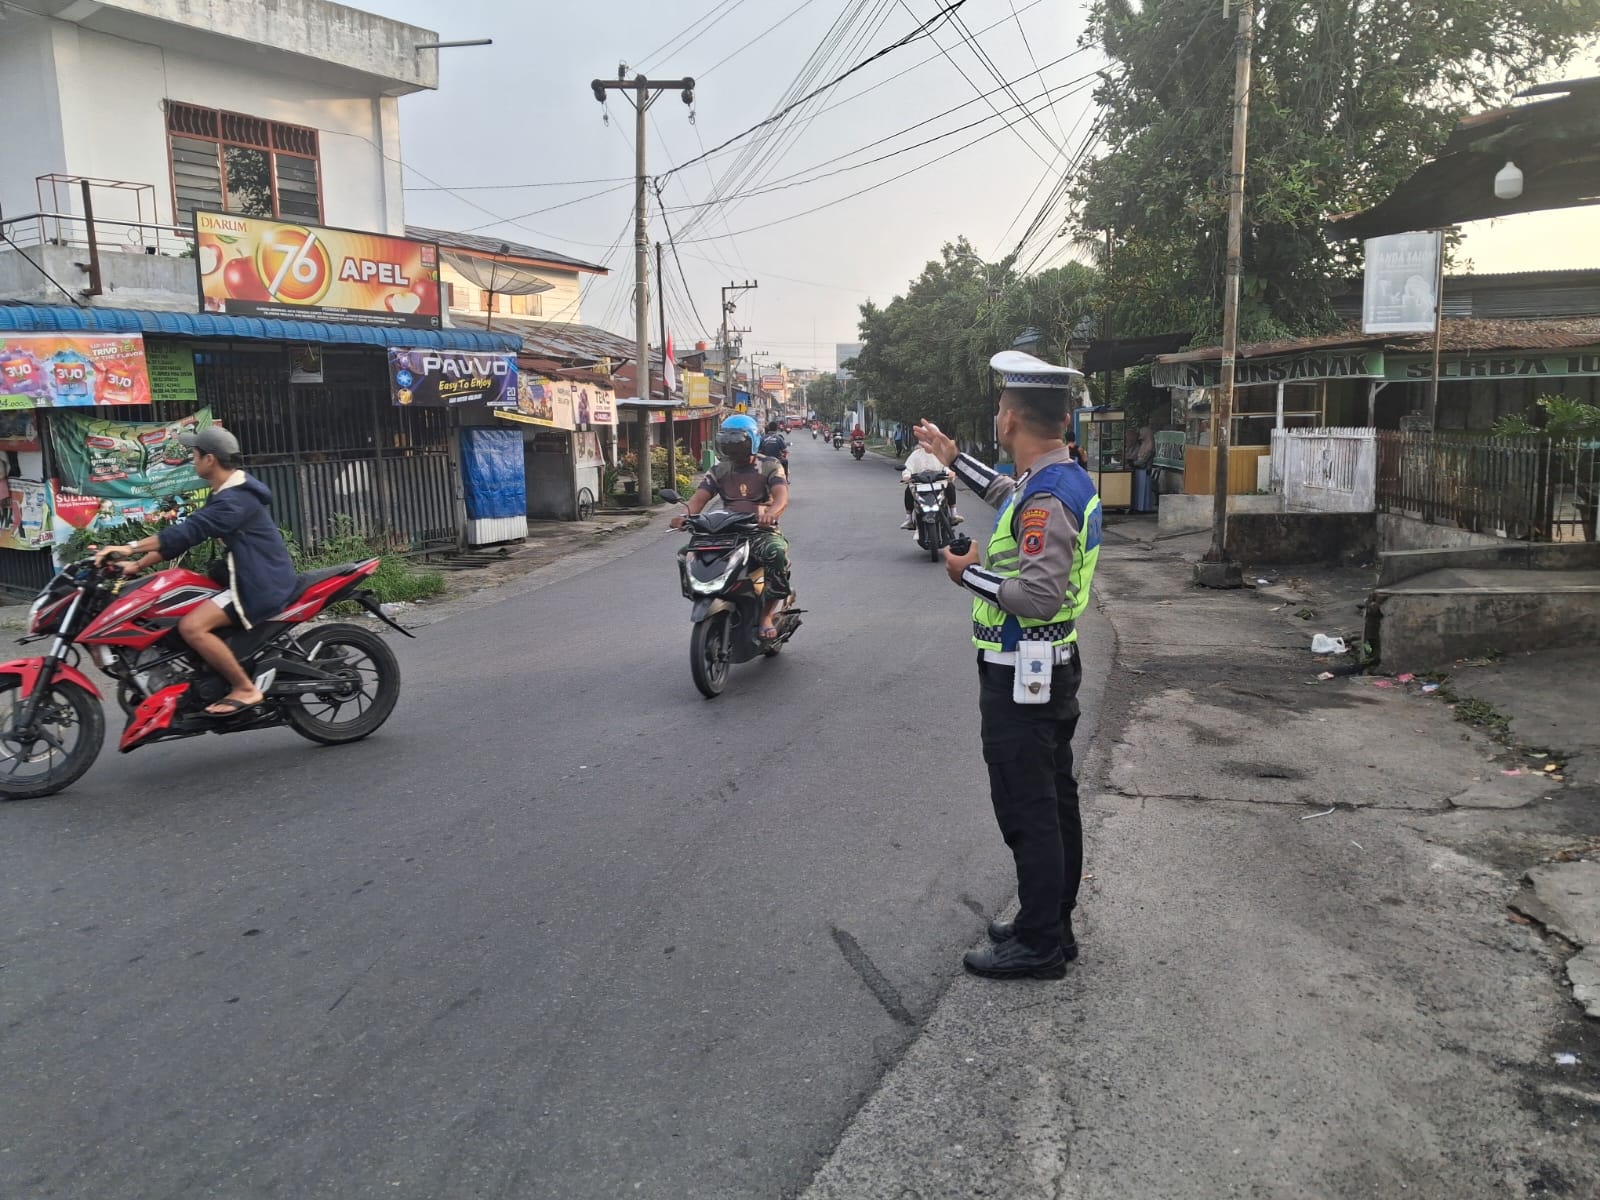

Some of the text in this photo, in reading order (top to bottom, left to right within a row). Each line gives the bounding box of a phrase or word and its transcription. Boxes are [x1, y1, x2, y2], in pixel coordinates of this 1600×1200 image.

[201, 216, 248, 233] DJARUM
[268, 232, 317, 297] 76
[341, 258, 409, 286] APEL
[439, 378, 492, 391] Easy To Enjoy
[507, 386, 516, 397] 20
